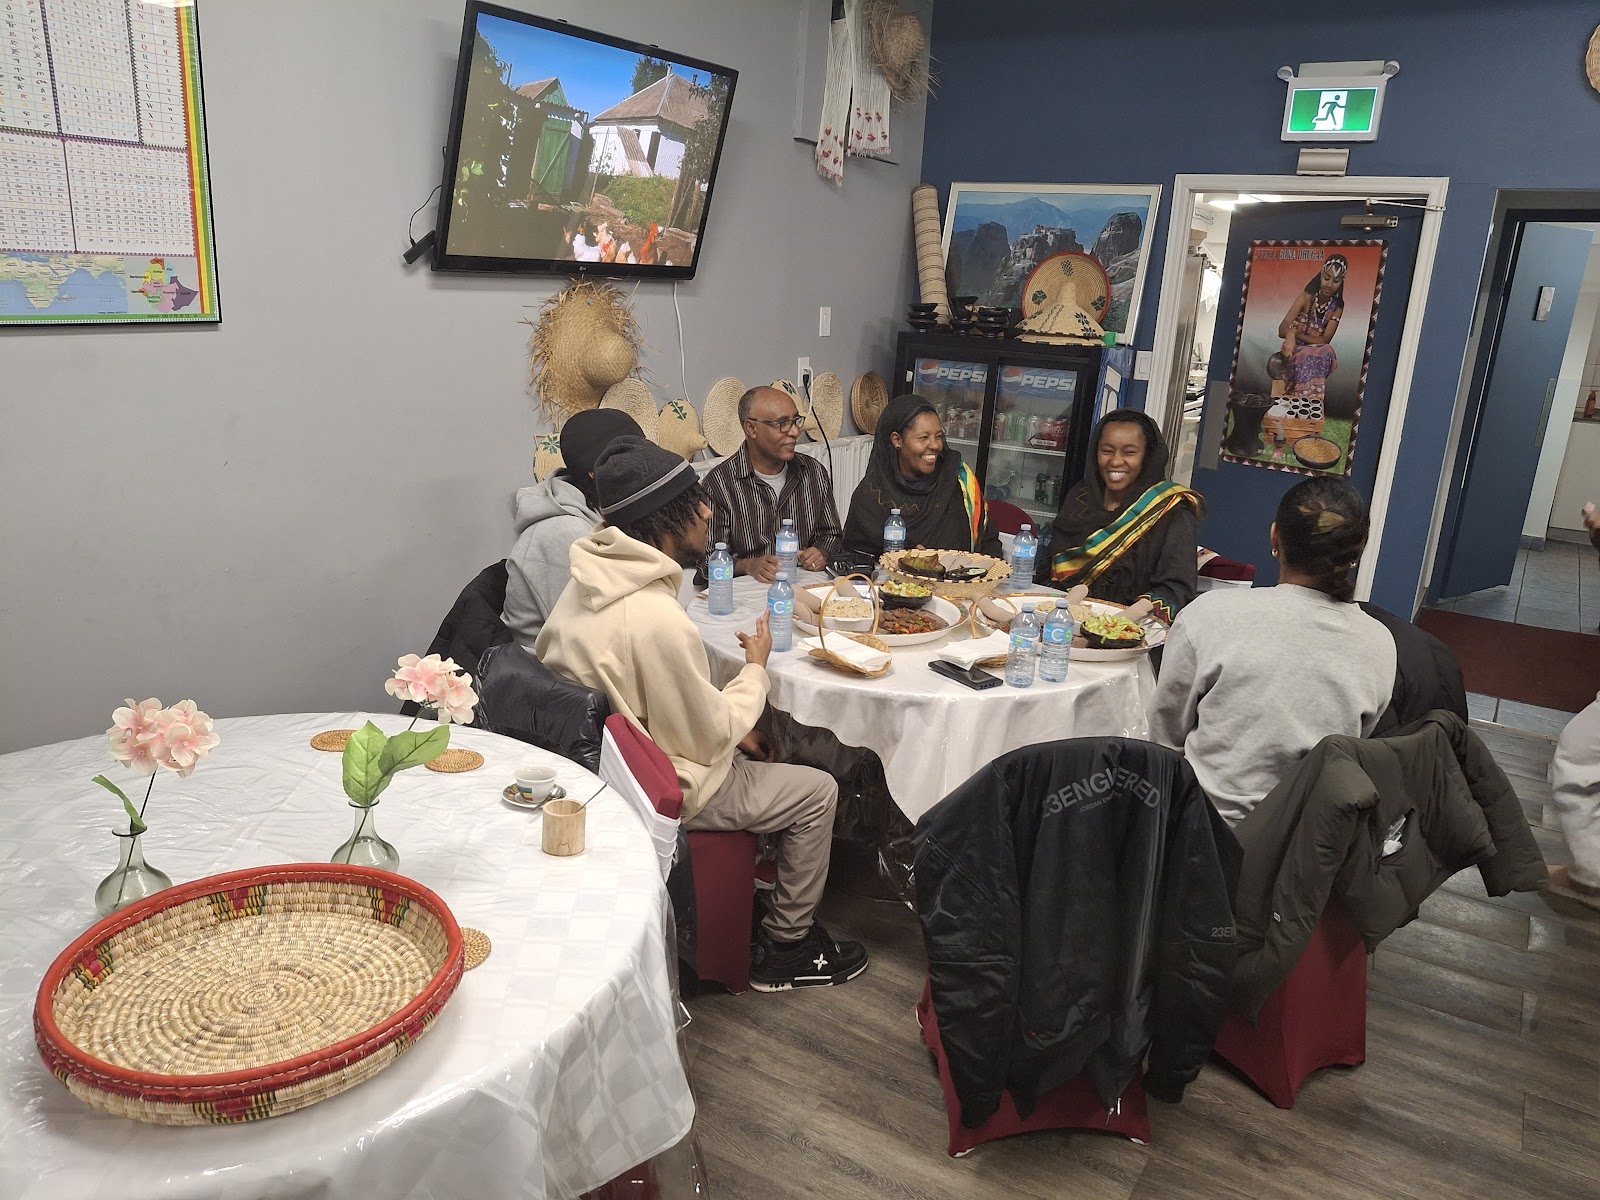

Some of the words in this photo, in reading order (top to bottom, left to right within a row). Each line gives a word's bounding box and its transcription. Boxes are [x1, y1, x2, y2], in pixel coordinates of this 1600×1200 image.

[937, 367, 987, 383] PEPSI
[1020, 375, 1076, 391] PEPSI
[713, 568, 723, 580] C
[774, 601, 784, 614] C
[1051, 628, 1064, 642] C
[1079, 799, 1102, 813] JORDAN
